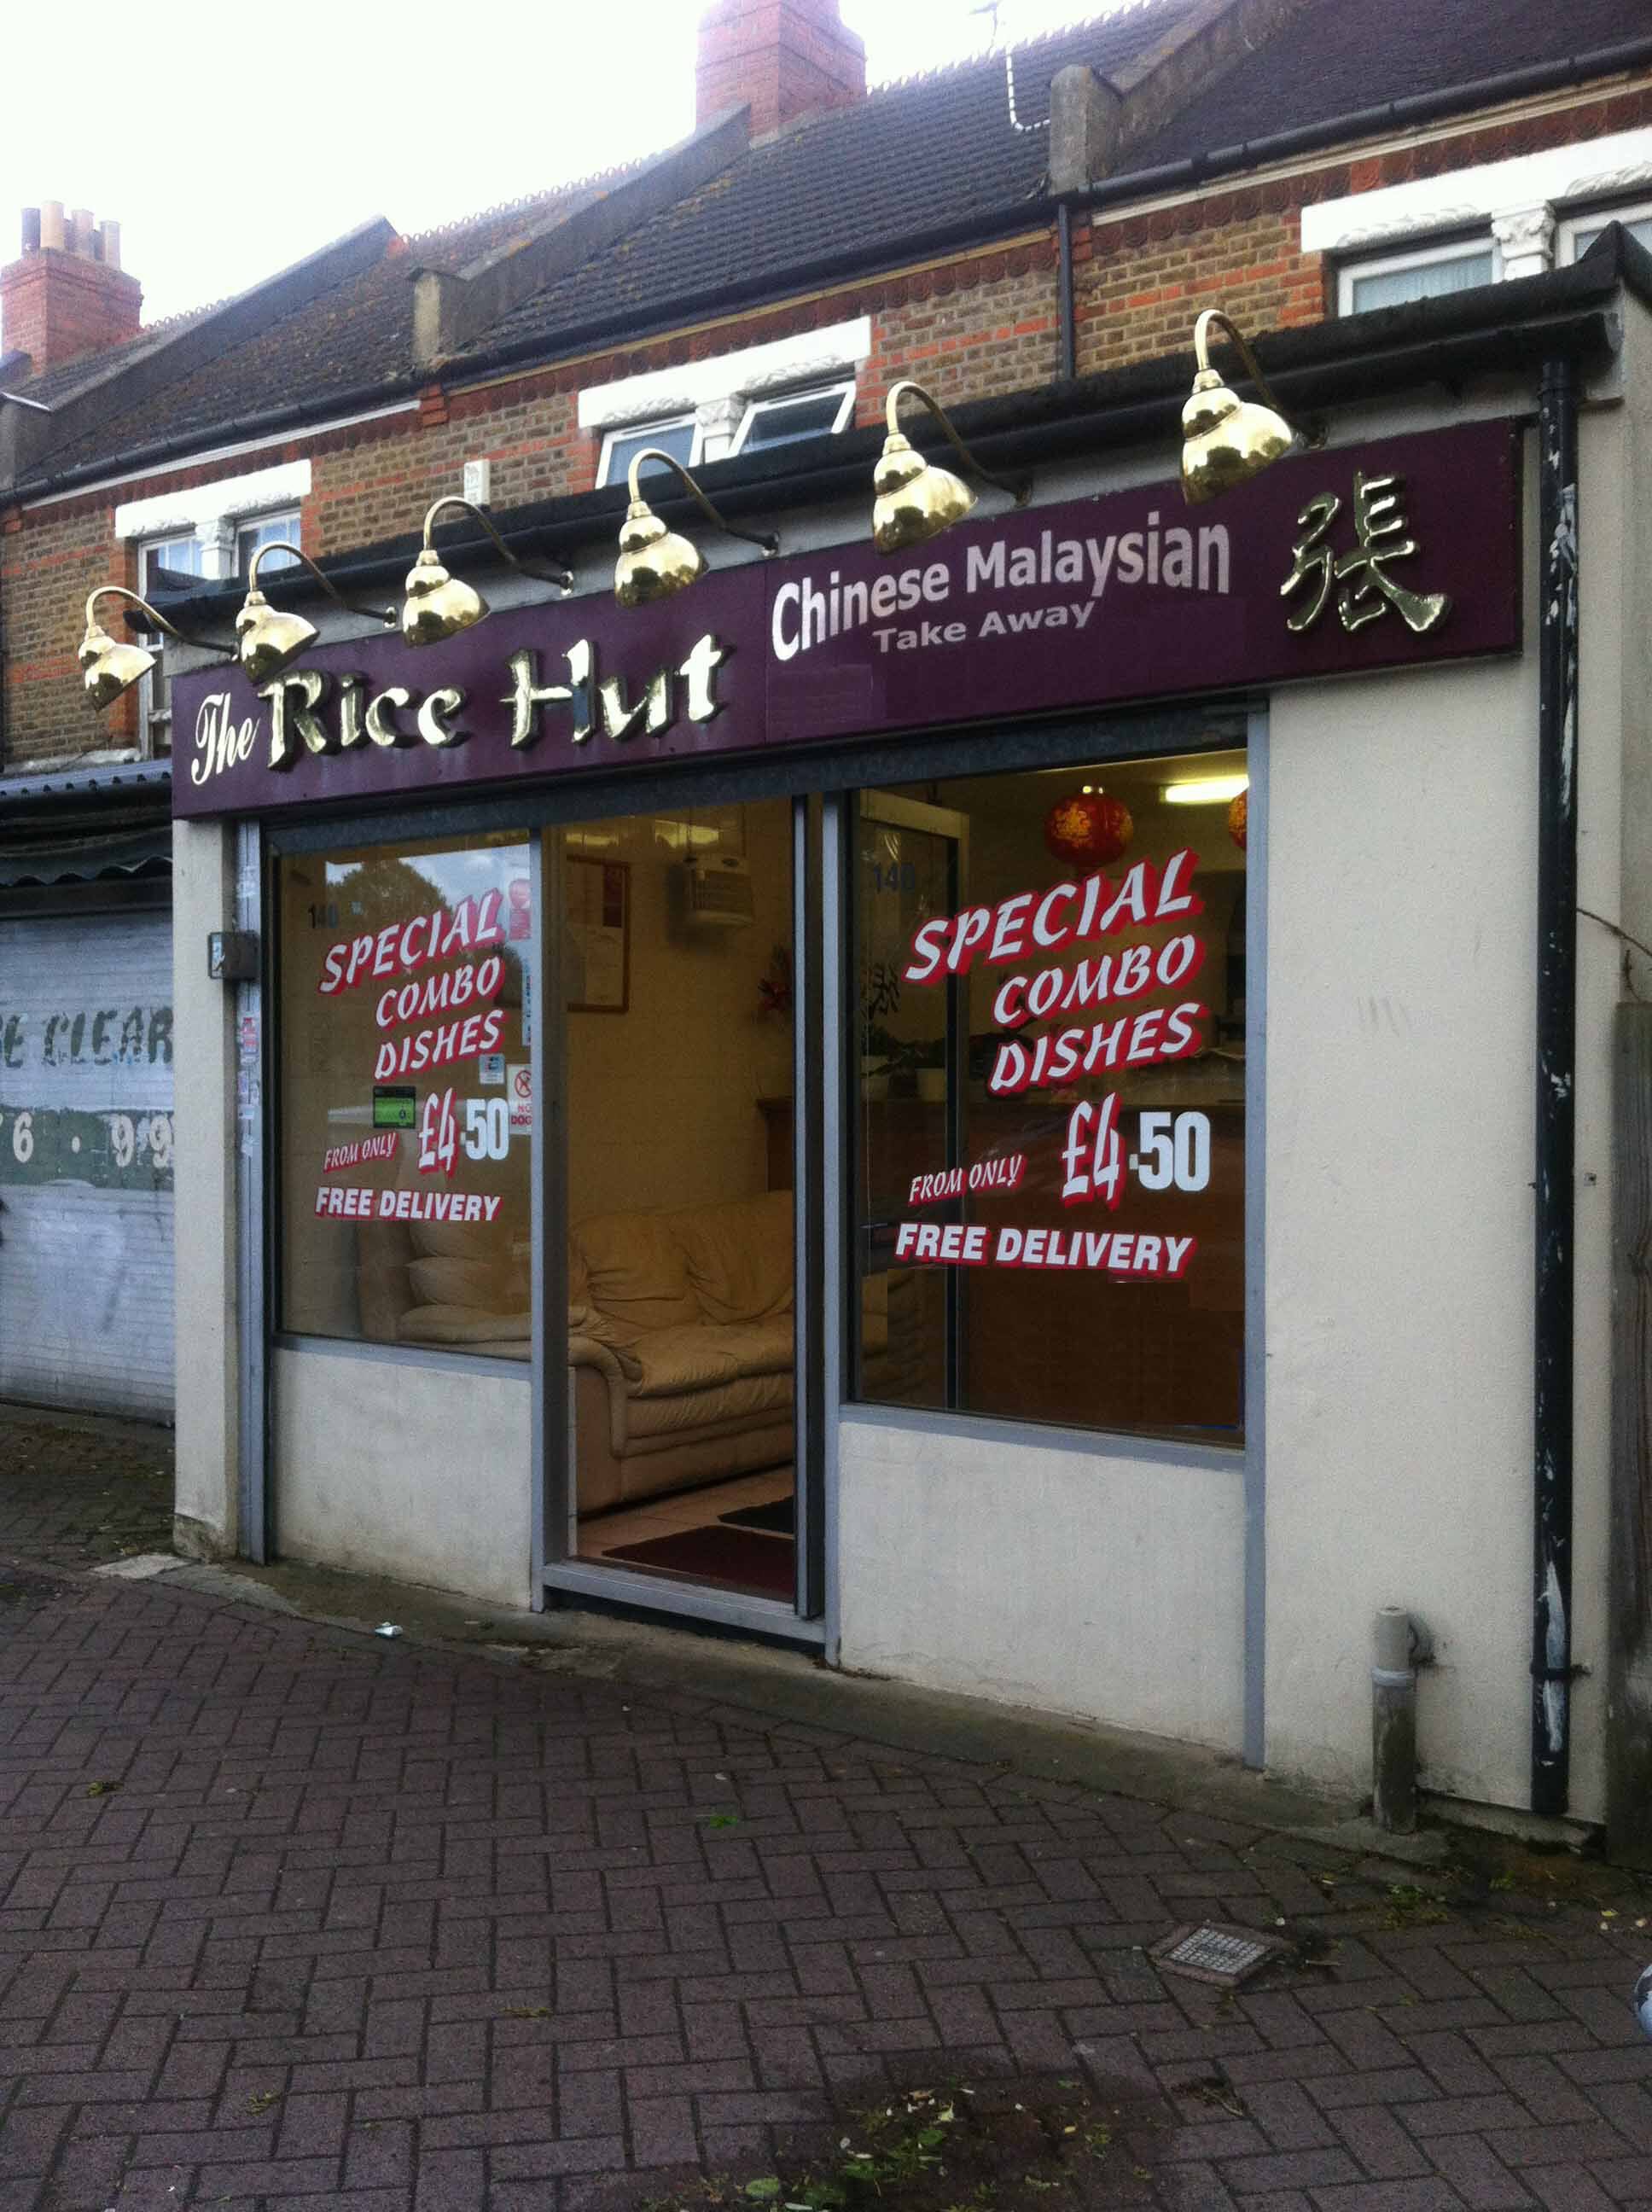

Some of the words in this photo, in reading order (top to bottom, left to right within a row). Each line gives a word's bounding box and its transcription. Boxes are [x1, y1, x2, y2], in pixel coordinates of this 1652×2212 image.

[771, 561, 950, 661] Chinese
[966, 511, 1230, 597] Malaysian
[871, 621, 967, 654] Take
[978, 599, 1096, 638] Away
[190, 691, 259, 785] The
[257, 669, 468, 770] Rice
[499, 633, 727, 750] Hut
[319, 888, 502, 995] SPECIAL
[904, 850, 1199, 984] SPECIAL
[375, 955, 503, 1029] COMBO
[992, 934, 1200, 1027] COMBO
[374, 1009, 506, 1081] DISHES
[990, 1001, 1204, 1094] DISHES
[323, 1142, 359, 1171] FROM
[361, 1132, 397, 1161] ONLY
[417, 1086, 510, 1173] £4.50
[1061, 1091, 1212, 1204] £4.50
[315, 1186, 373, 1216] FREE
[378, 1191, 502, 1221] DELIVERY
[908, 1168, 963, 1204] FROM
[969, 1153, 1025, 1195] ONLY
[895, 1222, 989, 1263] FREE
[996, 1228, 1194, 1274] DELIVERY
